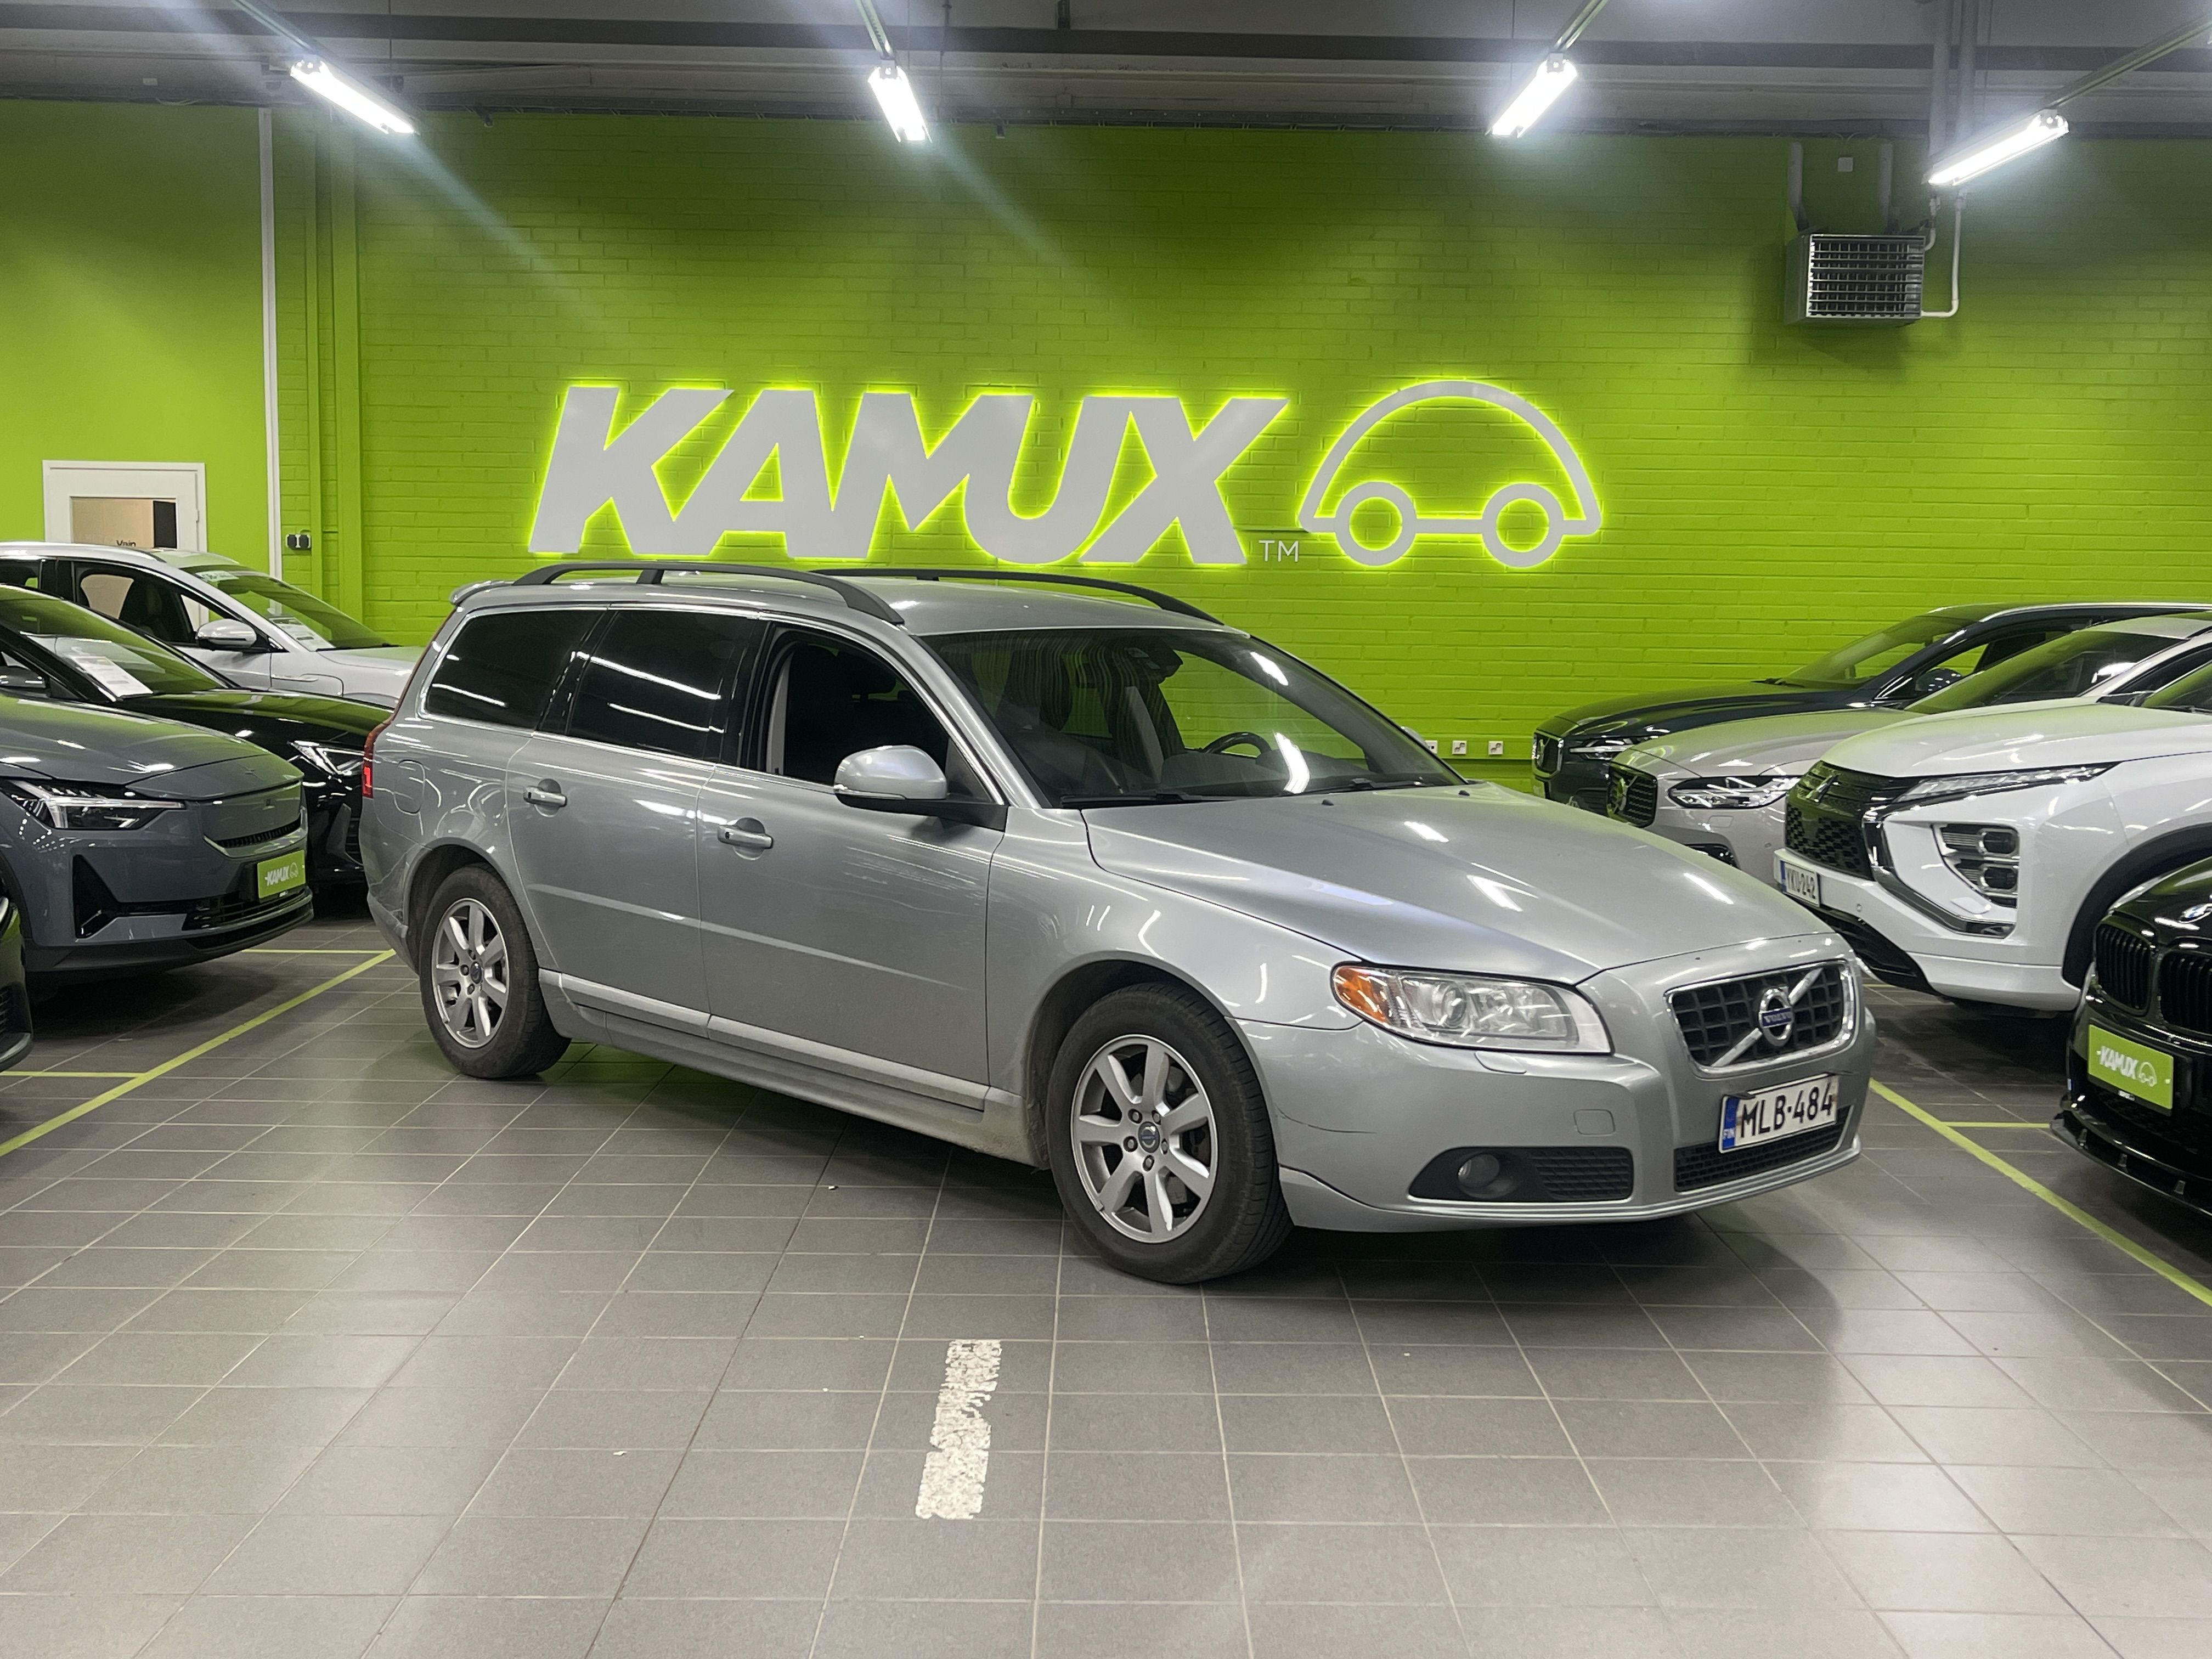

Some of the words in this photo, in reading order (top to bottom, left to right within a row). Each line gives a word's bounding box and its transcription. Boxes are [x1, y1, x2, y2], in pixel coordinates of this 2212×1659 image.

[528, 386, 1289, 564] KAMUX
[1259, 540, 1299, 562] TM
[266, 865, 290, 887] KAMUX
[2099, 1045, 2139, 1080] KAMUX
[1741, 1082, 1833, 1138] MLB-484
